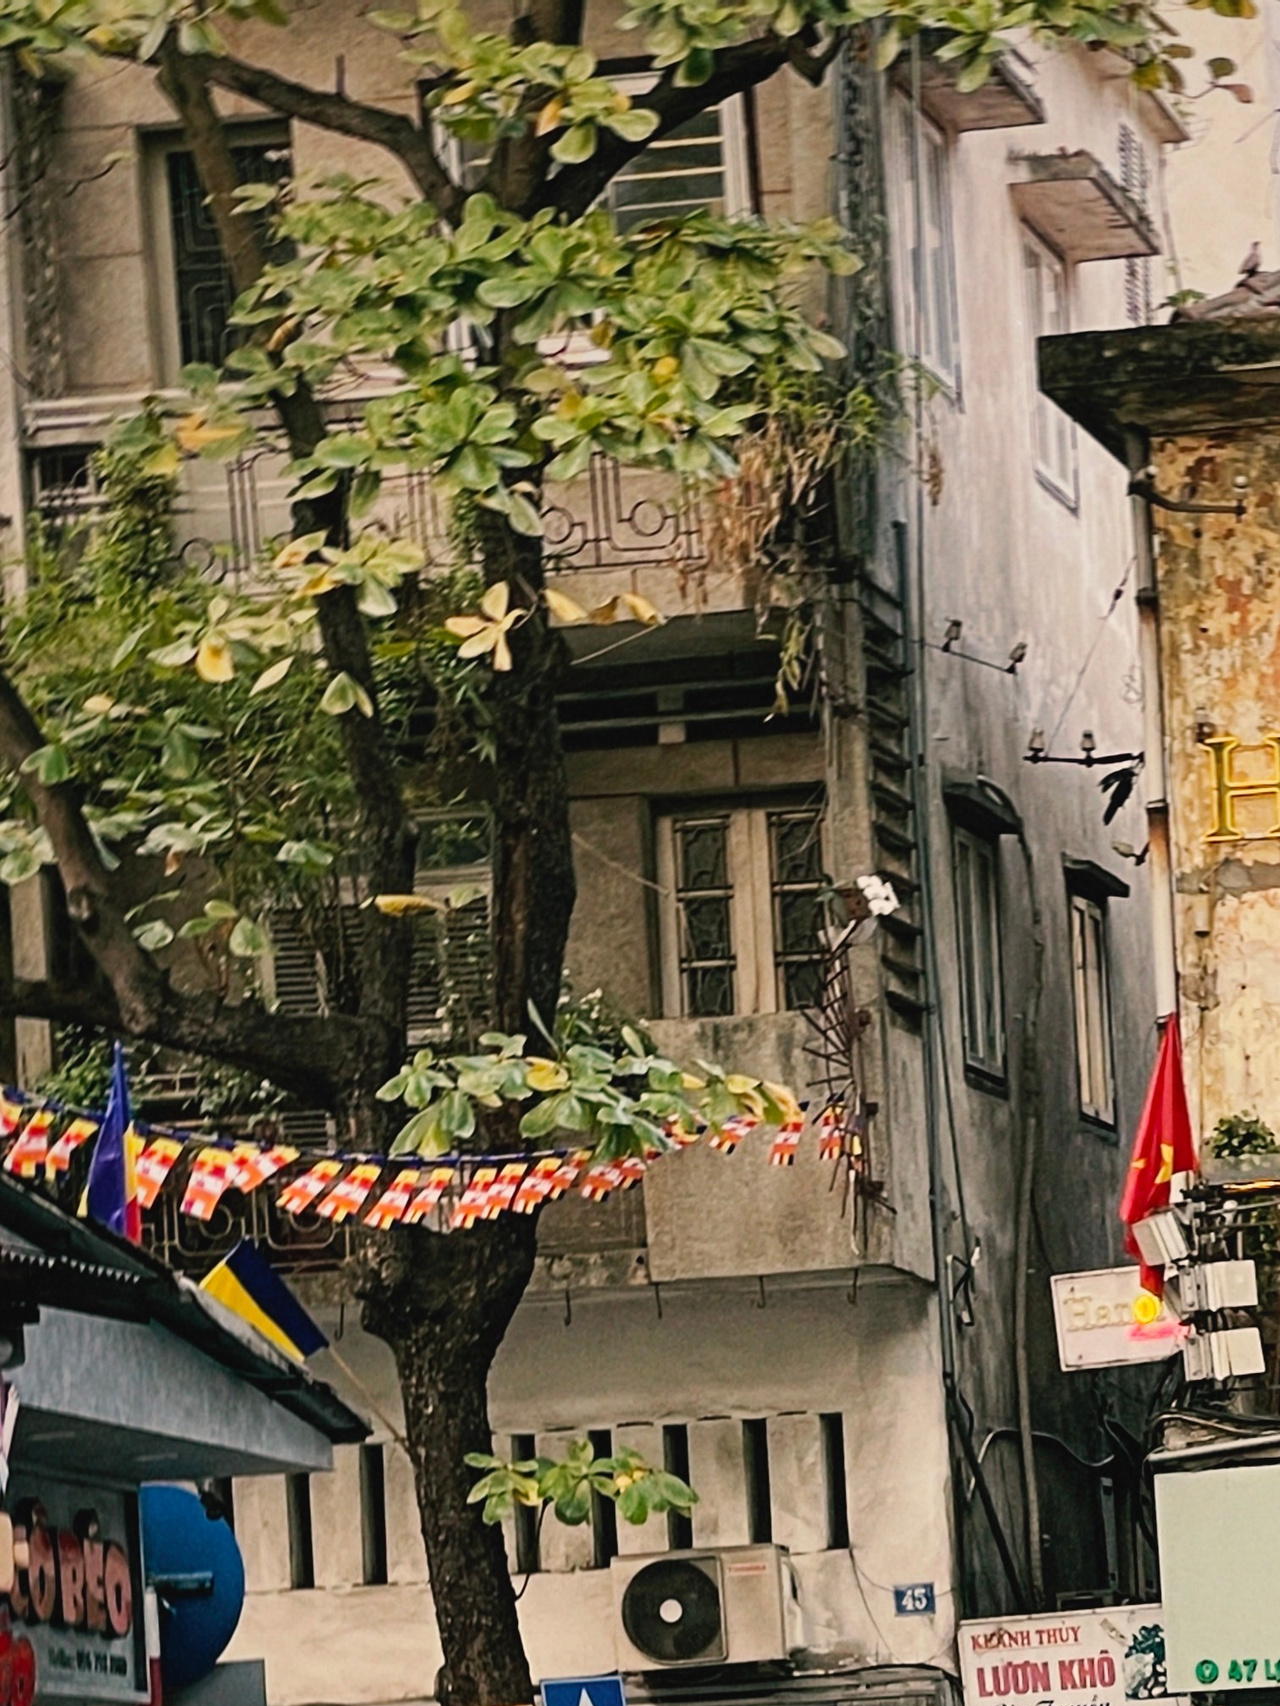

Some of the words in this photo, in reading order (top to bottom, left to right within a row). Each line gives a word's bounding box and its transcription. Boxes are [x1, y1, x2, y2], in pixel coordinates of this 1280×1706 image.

[901, 1587, 928, 1611] 45
[1059, 1649, 1116, 1691] KHÔ
[1228, 1659, 1258, 1683] 47
